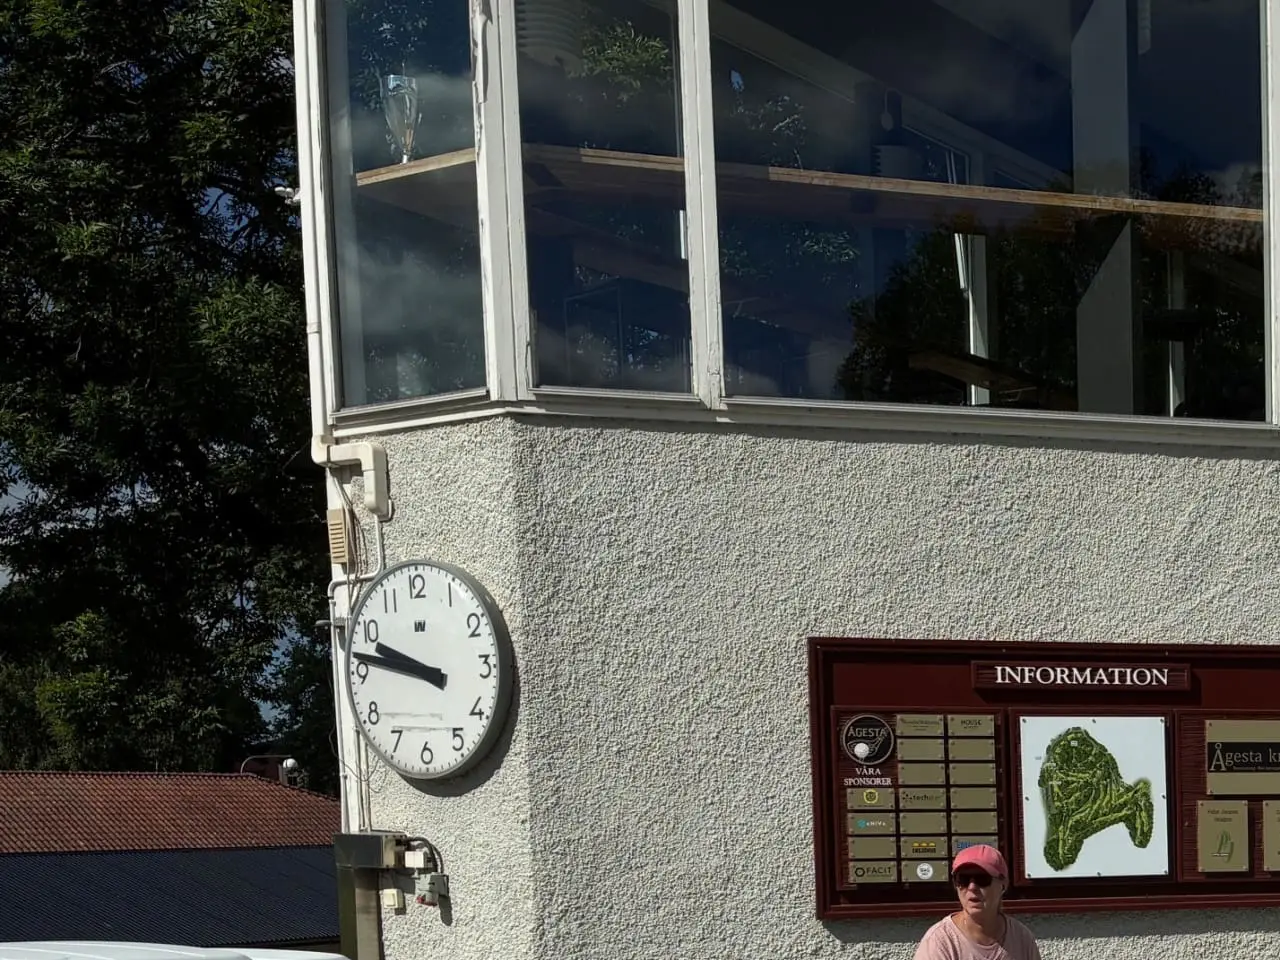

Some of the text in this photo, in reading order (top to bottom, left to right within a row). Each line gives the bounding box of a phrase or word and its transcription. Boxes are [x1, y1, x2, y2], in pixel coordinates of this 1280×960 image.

[409, 574, 426, 599] 12
[384, 588, 397, 613] 11
[363, 619, 379, 644] 10
[467, 613, 481, 638] 2
[356, 661, 369, 685] 9
[478, 654, 492, 679] 3
[994, 666, 1169, 686] INFORMATION
[368, 701, 380, 725] 8
[469, 696, 484, 720] 4
[391, 729, 403, 753] 7
[452, 727, 464, 751] 5
[848, 725, 888, 738] ÅGESTA
[420, 741, 434, 765] 6
[1209, 742, 1262, 771] Ågesta
[844, 778, 892, 786] SPONSORER
[855, 766, 881, 775] VÅRA
[866, 866, 892, 875] FACIT
